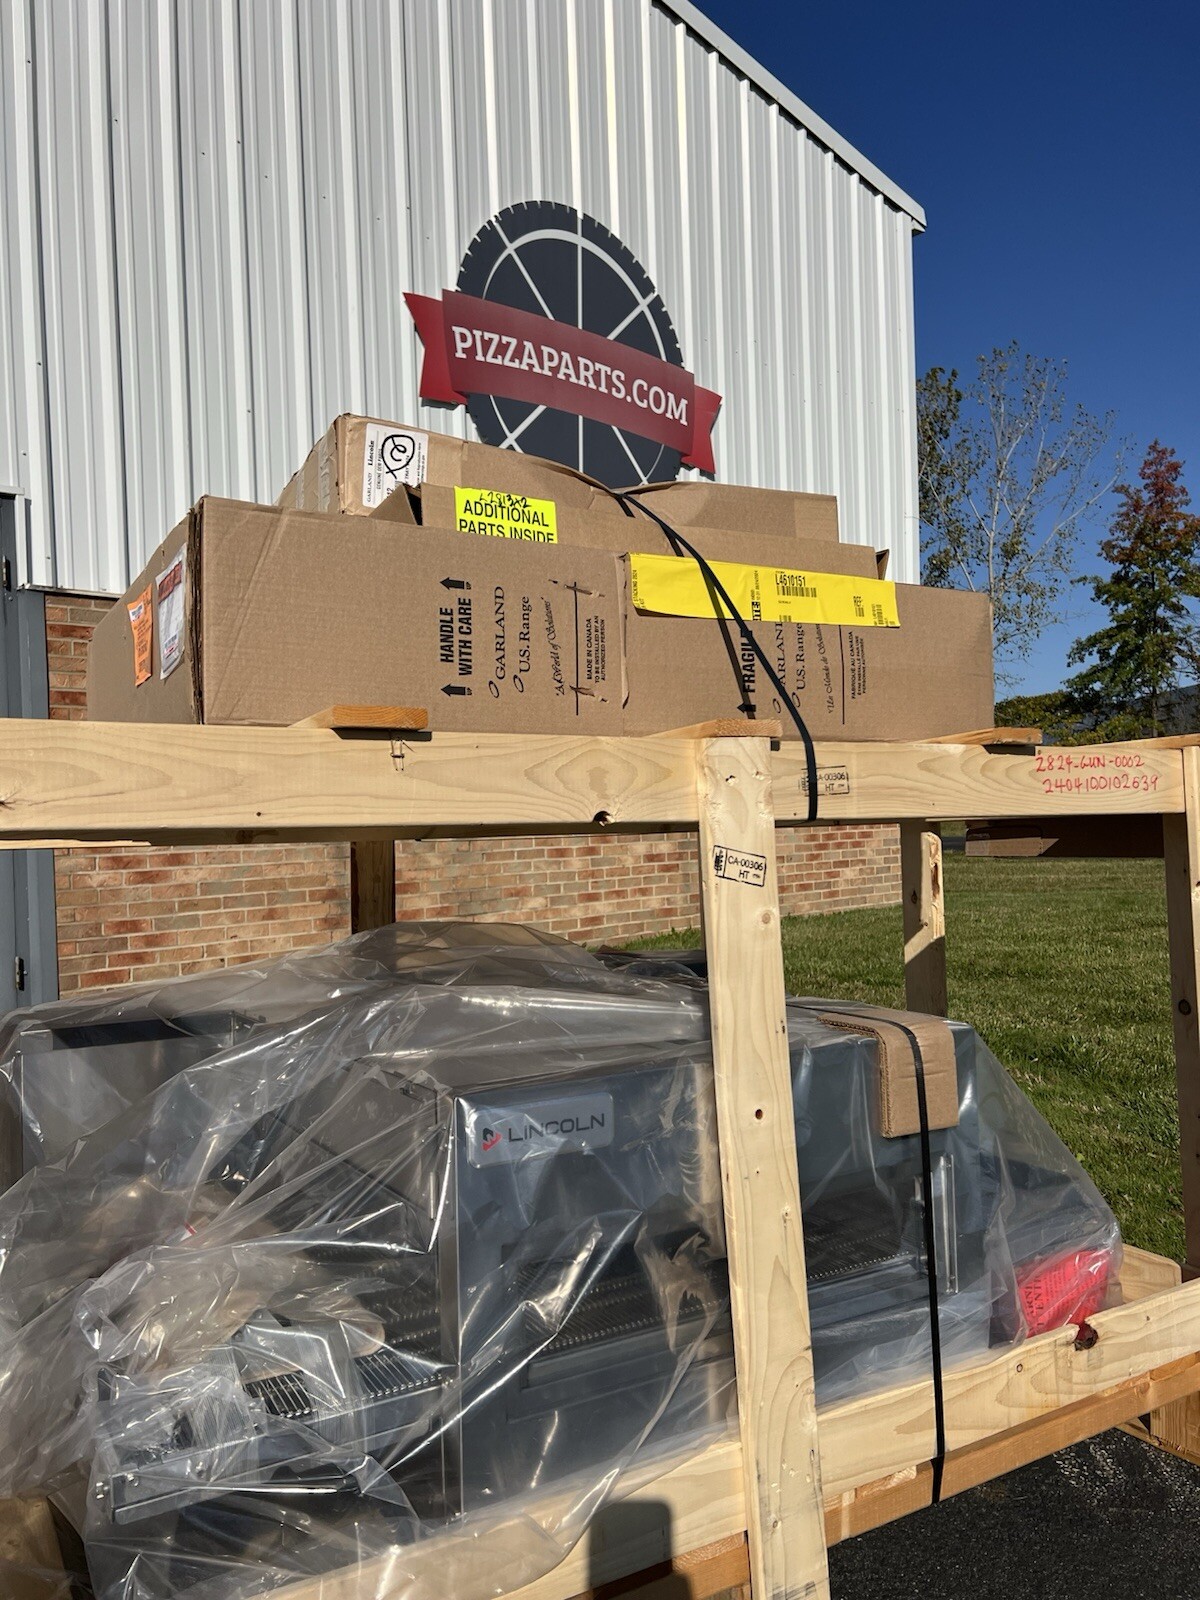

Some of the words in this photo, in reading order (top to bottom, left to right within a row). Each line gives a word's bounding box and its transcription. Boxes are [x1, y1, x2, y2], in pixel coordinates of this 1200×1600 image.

[452, 325, 689, 427] PIZZAPARTS.COM
[367, 440, 375, 466] Lincoln
[463, 499, 549, 527] ADDITIONAL
[459, 518, 505, 538] PARTS
[509, 526, 554, 543] INSIDE
[775, 573, 806, 587] L4610151
[458, 597, 472, 636] CARE
[519, 596, 533, 643] Range
[594, 615, 600, 624] AN
[594, 625, 600, 633] BY
[439, 607, 454, 663] HANDLE
[494, 586, 506, 680] GARLAND
[795, 623, 806, 662] Range
[458, 640, 472, 676] WITH
[519, 644, 531, 674] U.S.
[586, 649, 593, 657] IN
[774, 622, 786, 688] ARLAN
[850, 657, 856, 667] AU
[594, 666, 600, 675] BE
[594, 675, 600, 684] TO
[796, 665, 806, 690] U.S.
[817, 772, 846, 782] A-00306
[825, 783, 835, 792] HT
[1042, 774, 1159, 794] 2404100102639
[728, 855, 764, 872] CA-00306
[738, 869, 750, 880] HT
[508, 1113, 605, 1143] LINCOLN
